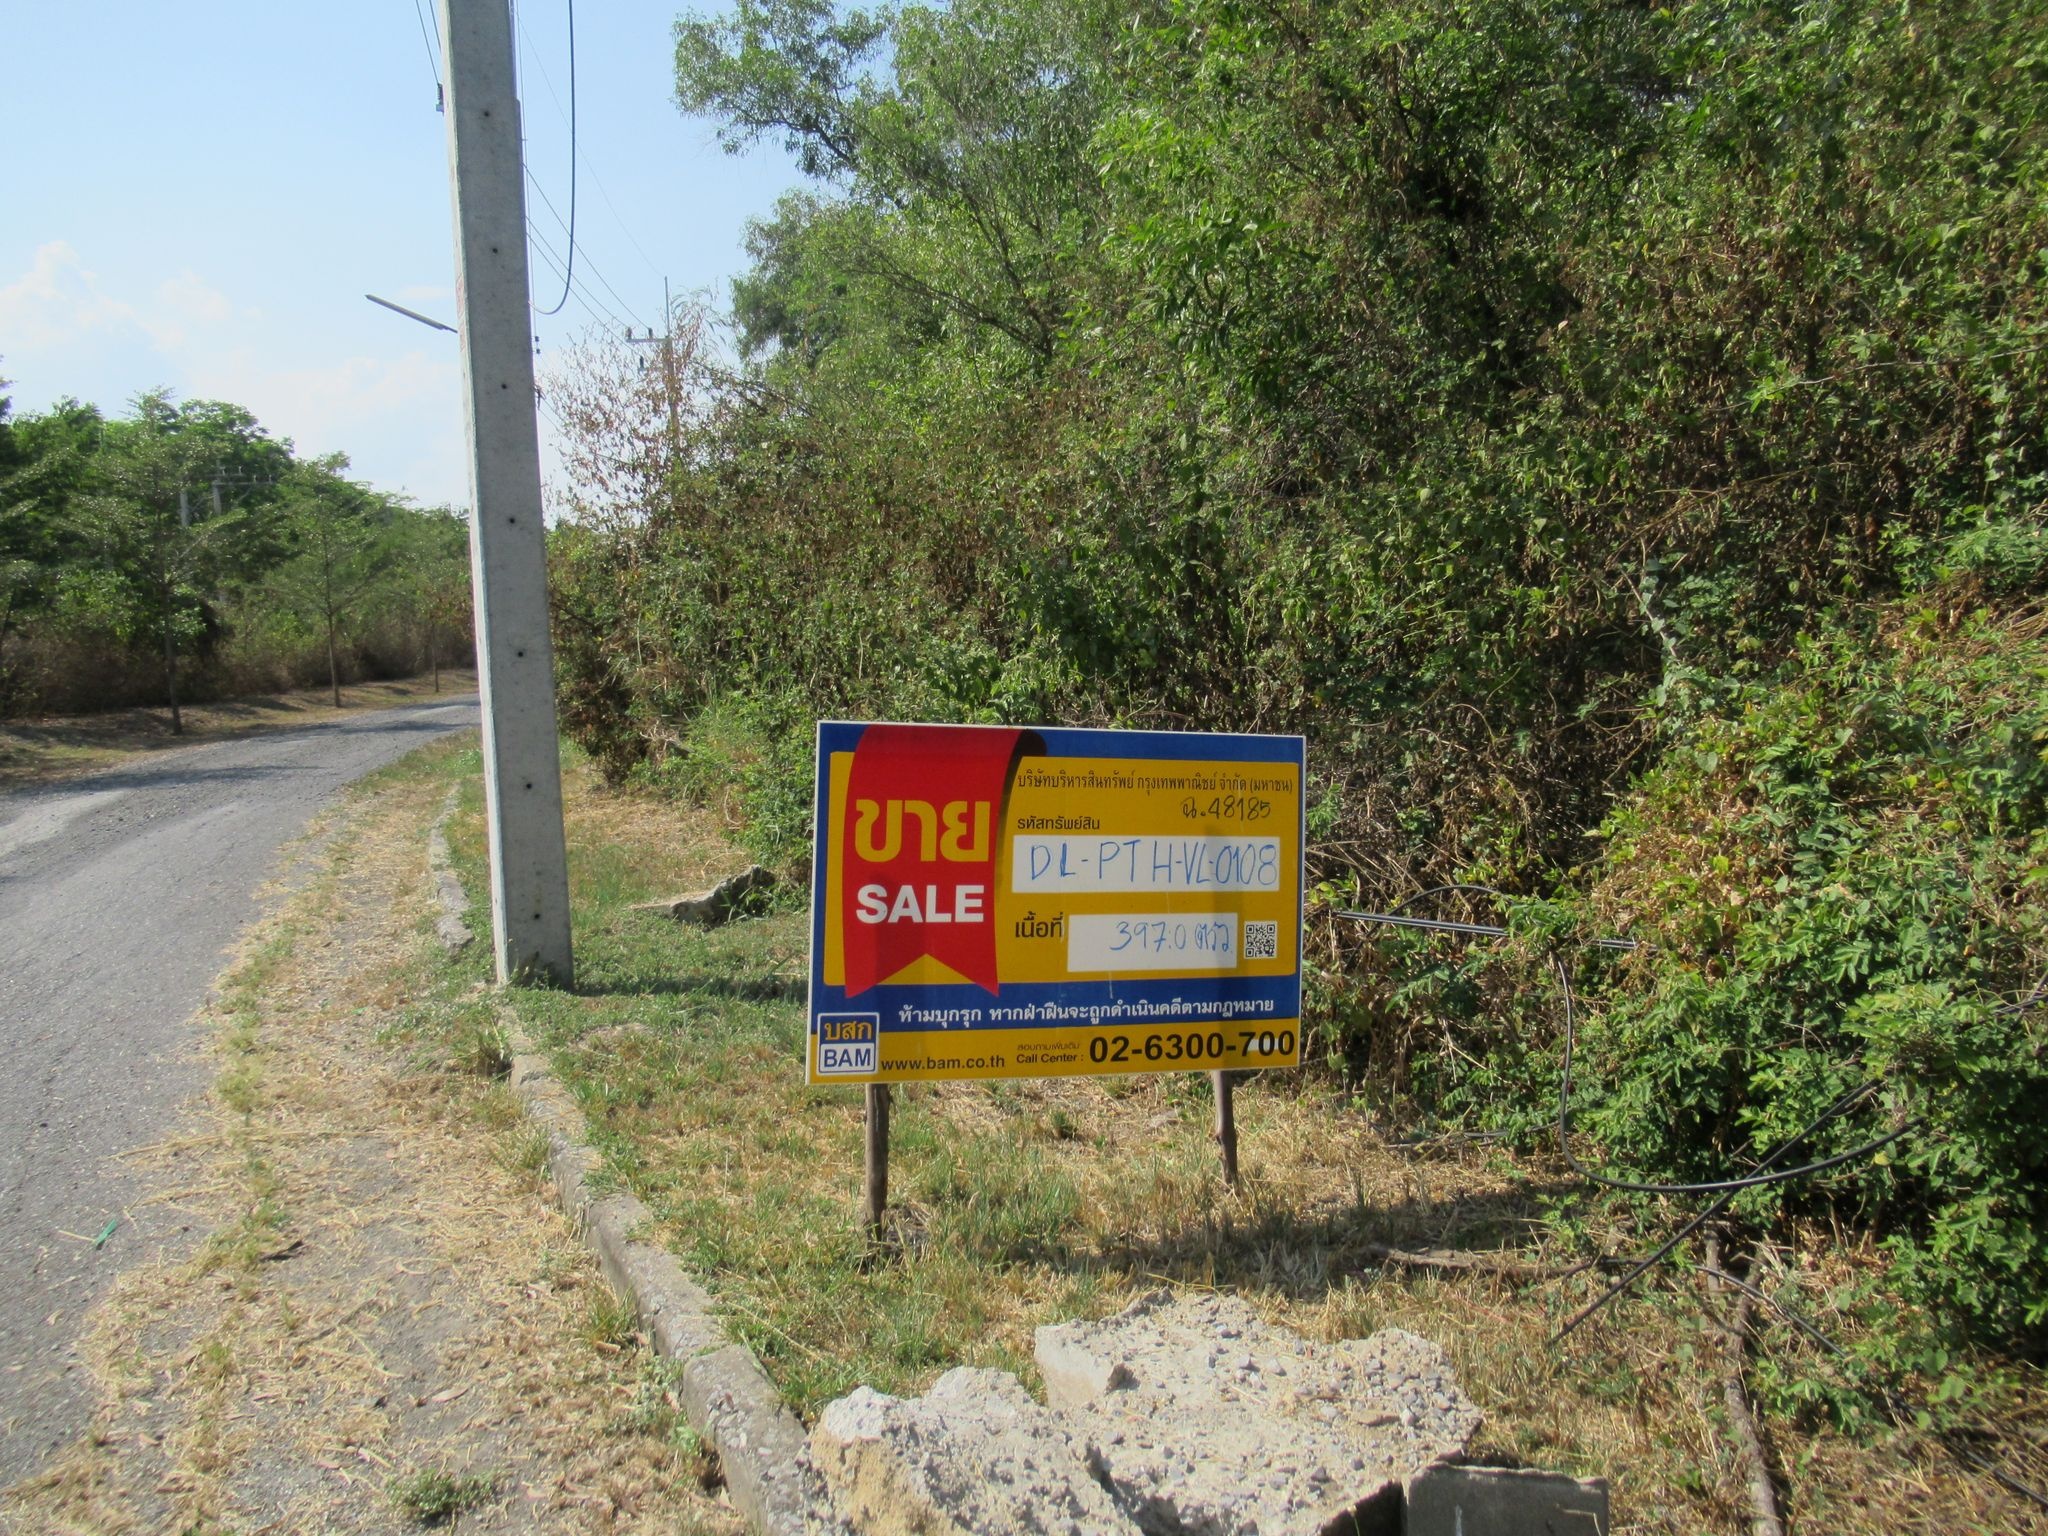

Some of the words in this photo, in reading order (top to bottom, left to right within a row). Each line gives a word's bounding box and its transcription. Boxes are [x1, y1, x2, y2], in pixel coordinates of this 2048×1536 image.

[1220, 773, 1247, 792] จำกัด
[1250, 777, 1293, 793] (มหาชน)
[855, 799, 991, 863] ขาย
[1017, 814, 1100, 831] รหัสทรัพย์สิน
[856, 883, 985, 924] SALE
[1015, 910, 1064, 939] เนื้อที่
[898, 1004, 981, 1029] ห้ามบุกรุก
[824, 1020, 872, 1041] บสก
[1089, 1030, 1295, 1063] 02-6300-700
[823, 1048, 871, 1068] BAM
[881, 1055, 1005, 1071] www.bam.co.th
[1016, 1053, 1038, 1064] Call
